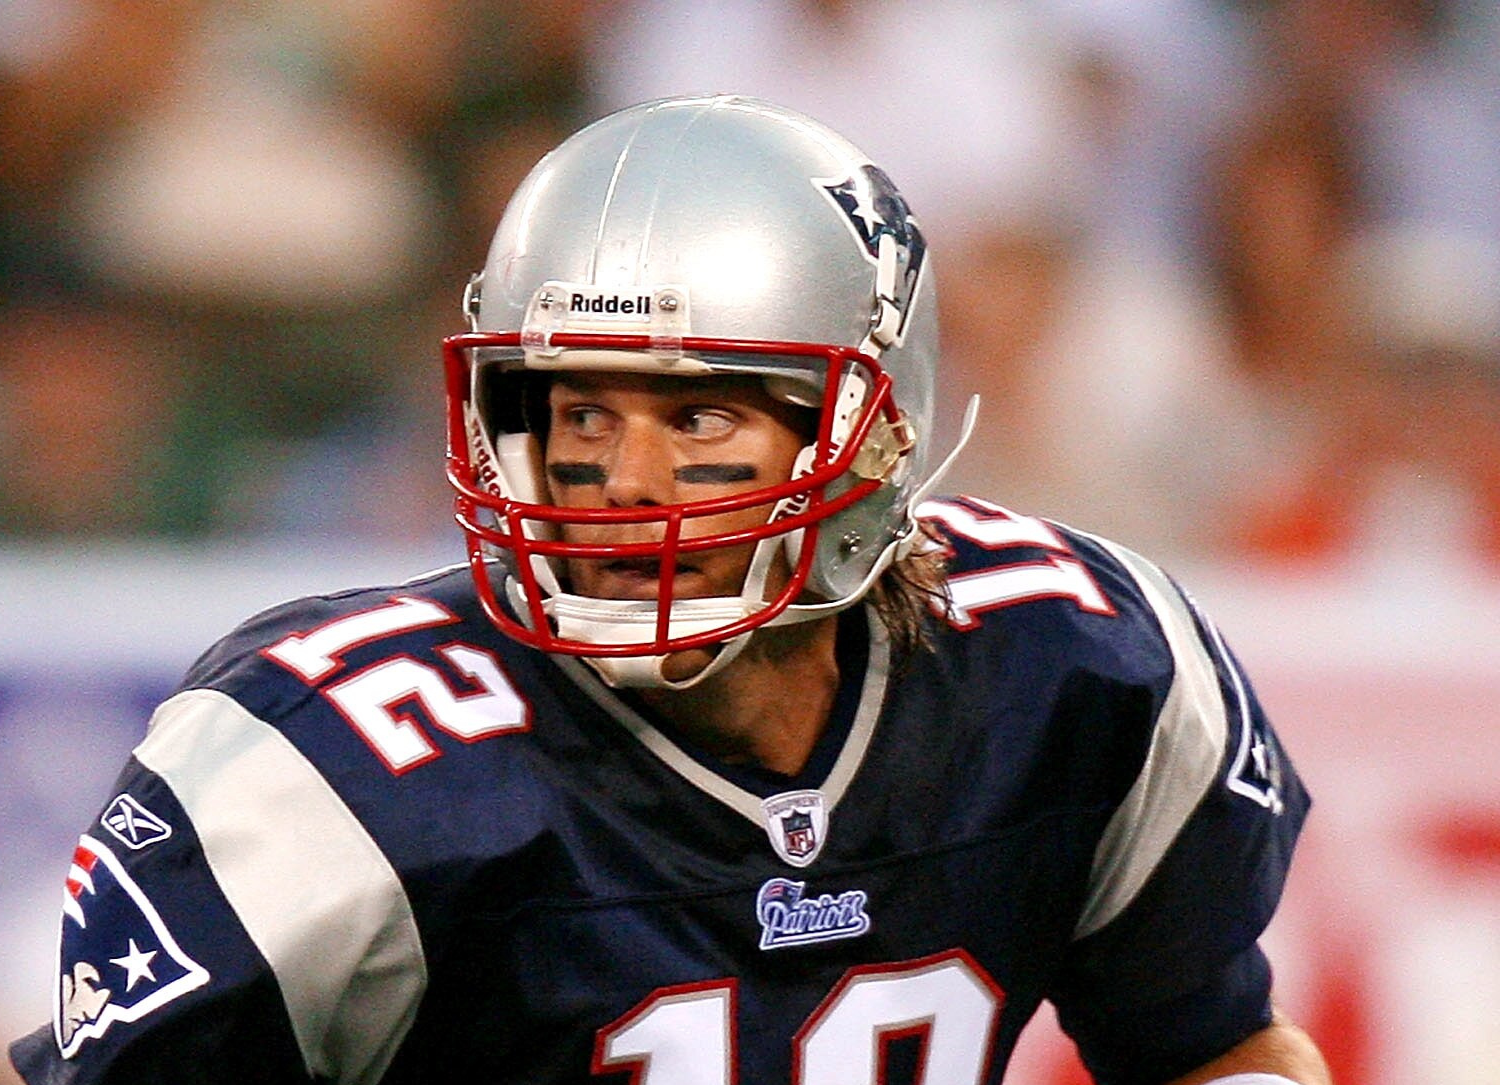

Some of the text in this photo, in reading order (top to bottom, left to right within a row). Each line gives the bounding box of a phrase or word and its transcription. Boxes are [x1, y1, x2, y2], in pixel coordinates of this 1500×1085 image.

[568, 293, 651, 314] Riddell
[258, 596, 535, 776] 12
[757, 881, 870, 949] Patriots
